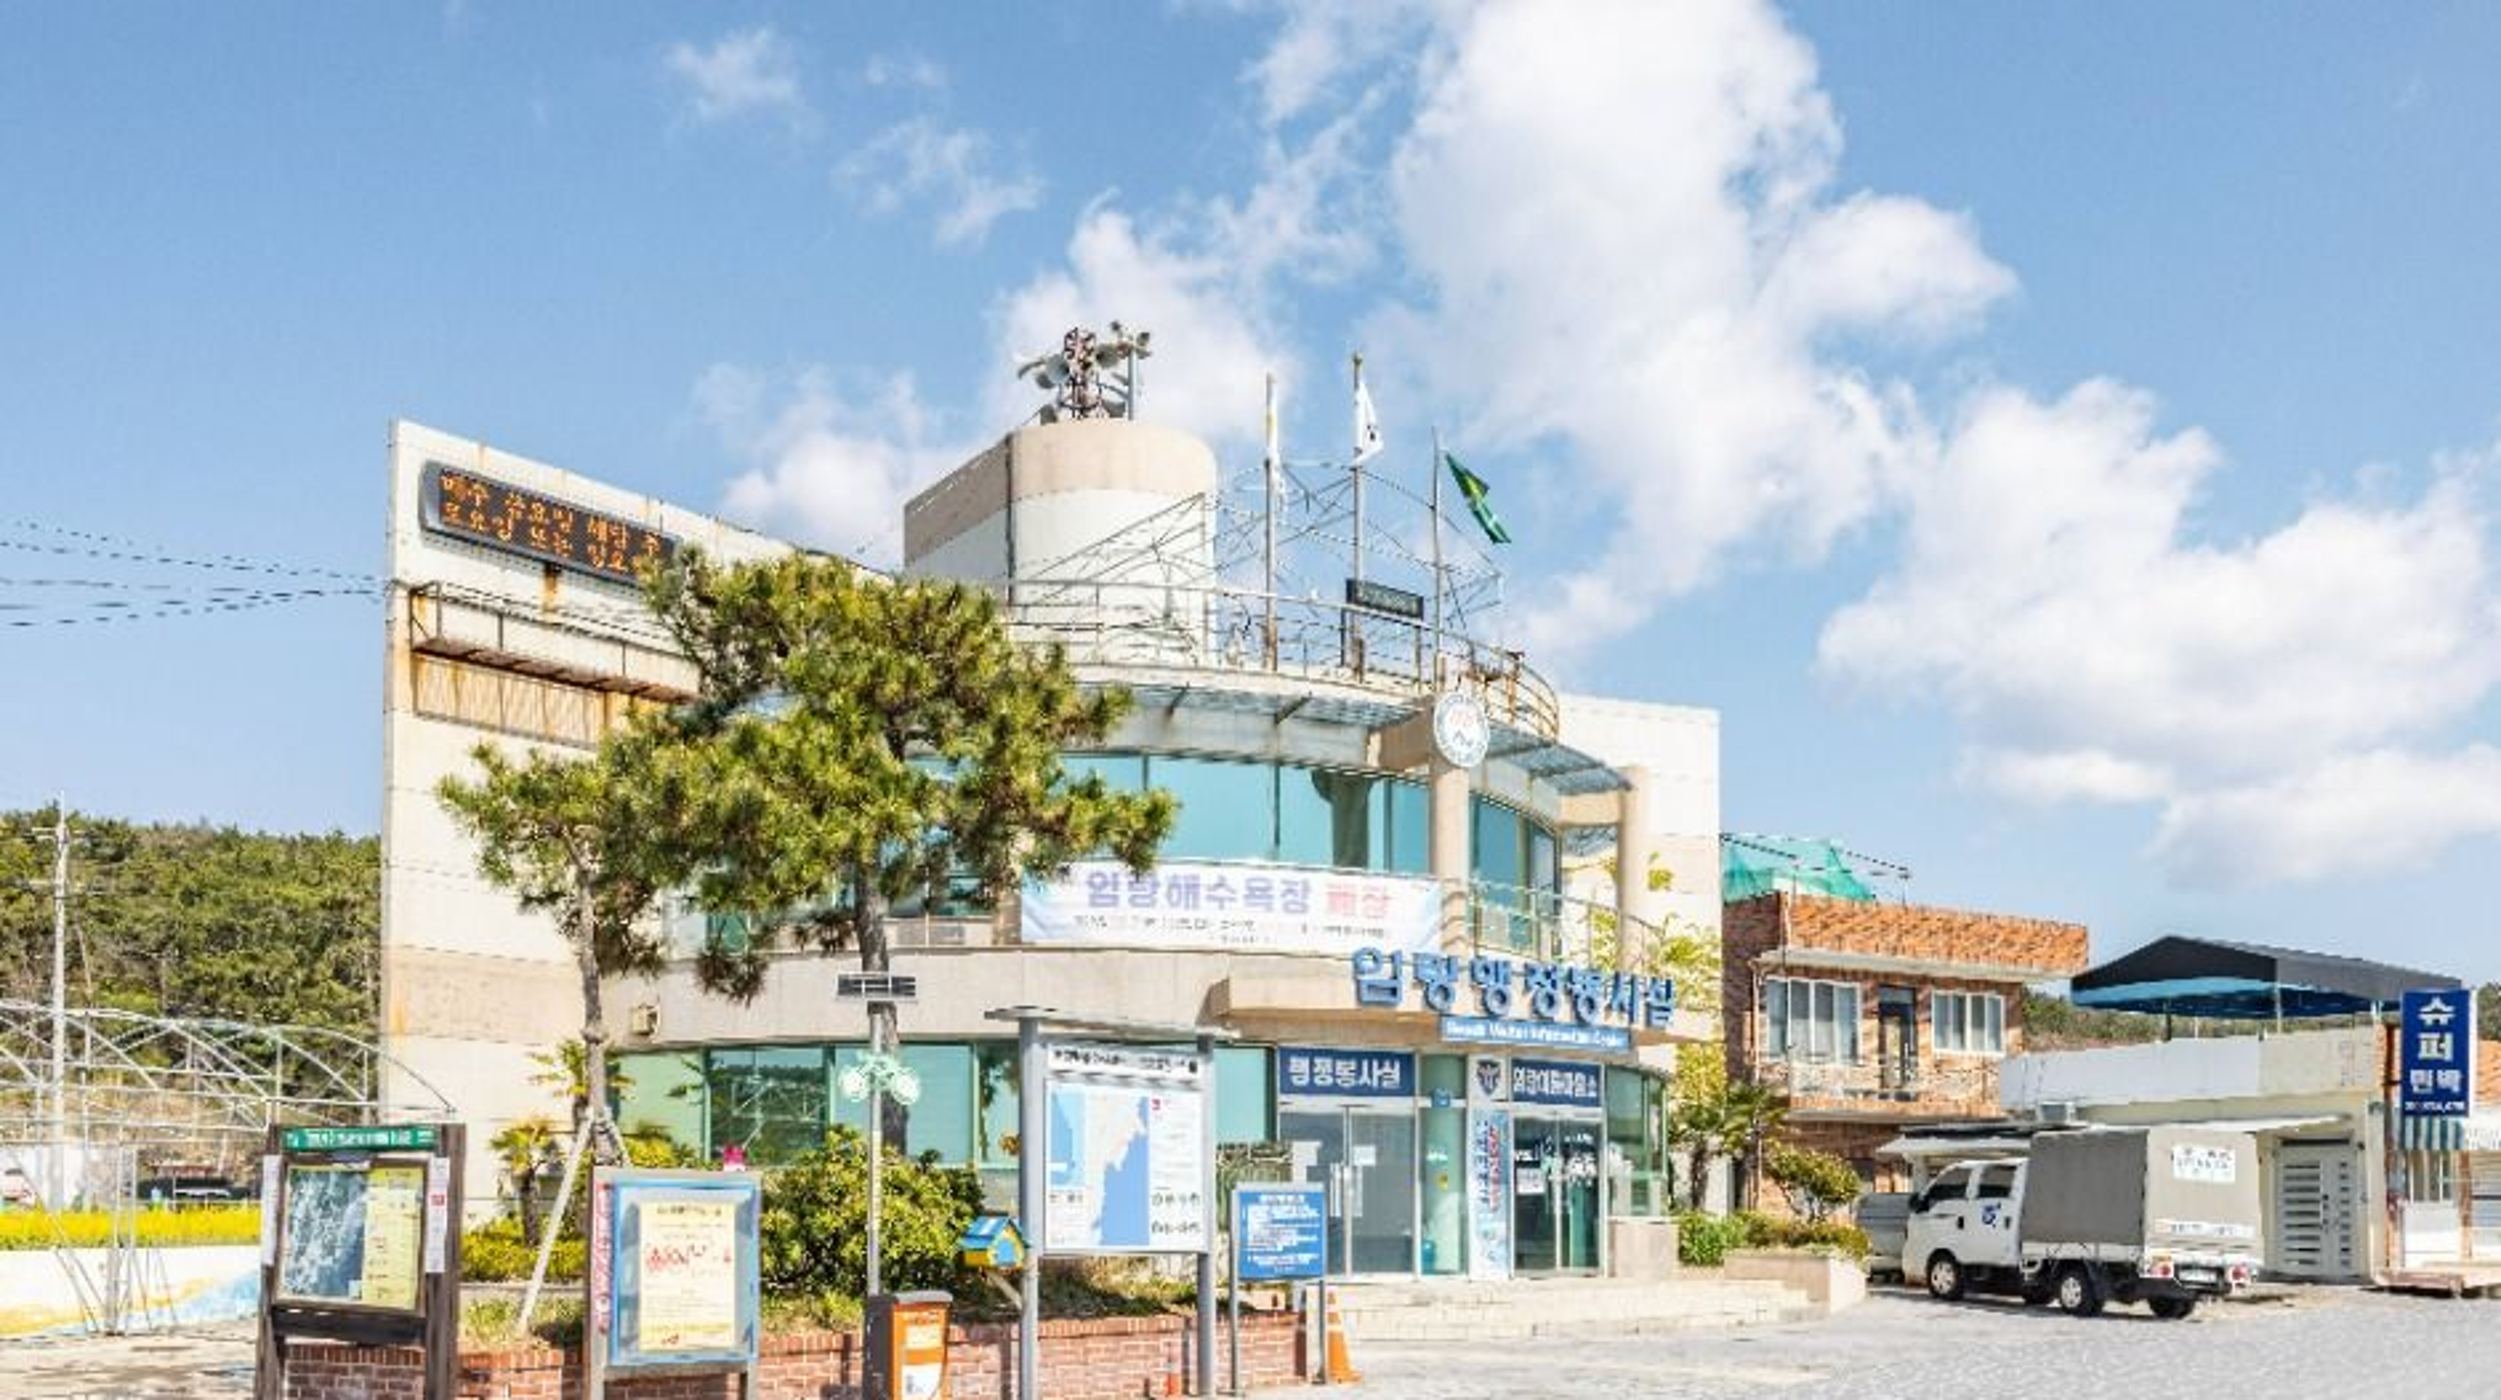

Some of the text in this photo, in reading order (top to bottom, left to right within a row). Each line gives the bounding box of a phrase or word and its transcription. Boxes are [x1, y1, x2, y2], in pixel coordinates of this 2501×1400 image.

[1085, 871, 1311, 915] 임랑해수욕장
[2418, 997, 2456, 1061] 슈퍼
[1288, 1055, 1401, 1090] 행정봉사실
